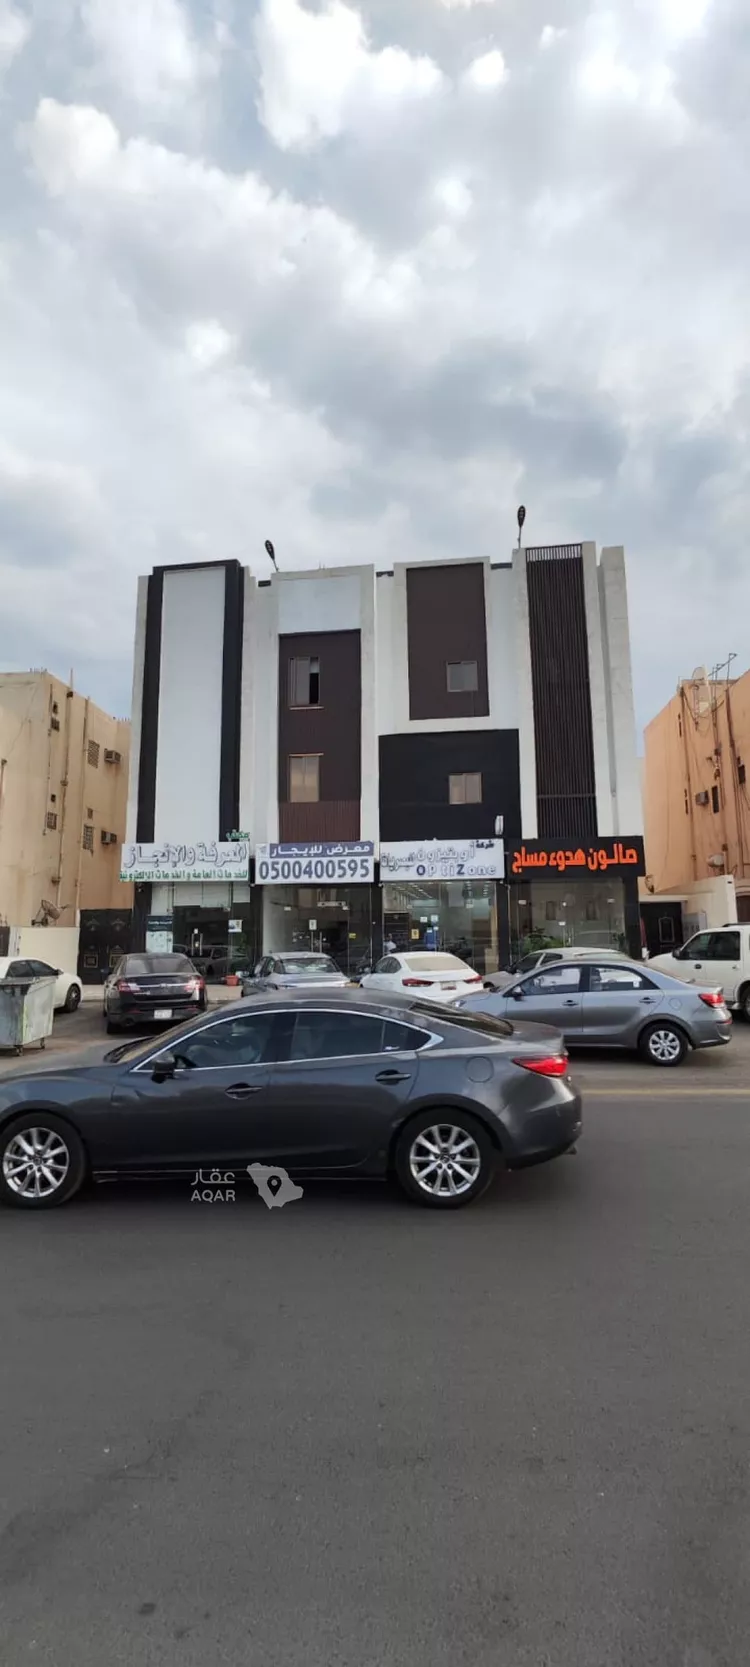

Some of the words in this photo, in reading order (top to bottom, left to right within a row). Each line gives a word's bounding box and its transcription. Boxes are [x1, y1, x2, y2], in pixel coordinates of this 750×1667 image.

[271, 844, 323, 857] للإيجار
[326, 843, 370, 855] معرض
[476, 839, 494, 849] شركة
[197, 842, 247, 867] المعرفة
[512, 846, 548, 873] مساج
[549, 848, 586, 871] هدوء
[588, 843, 638, 870] صالون
[192, 868, 216, 879] العامة
[259, 859, 369, 880] 0500400595
[416, 863, 496, 877] OptiZone
